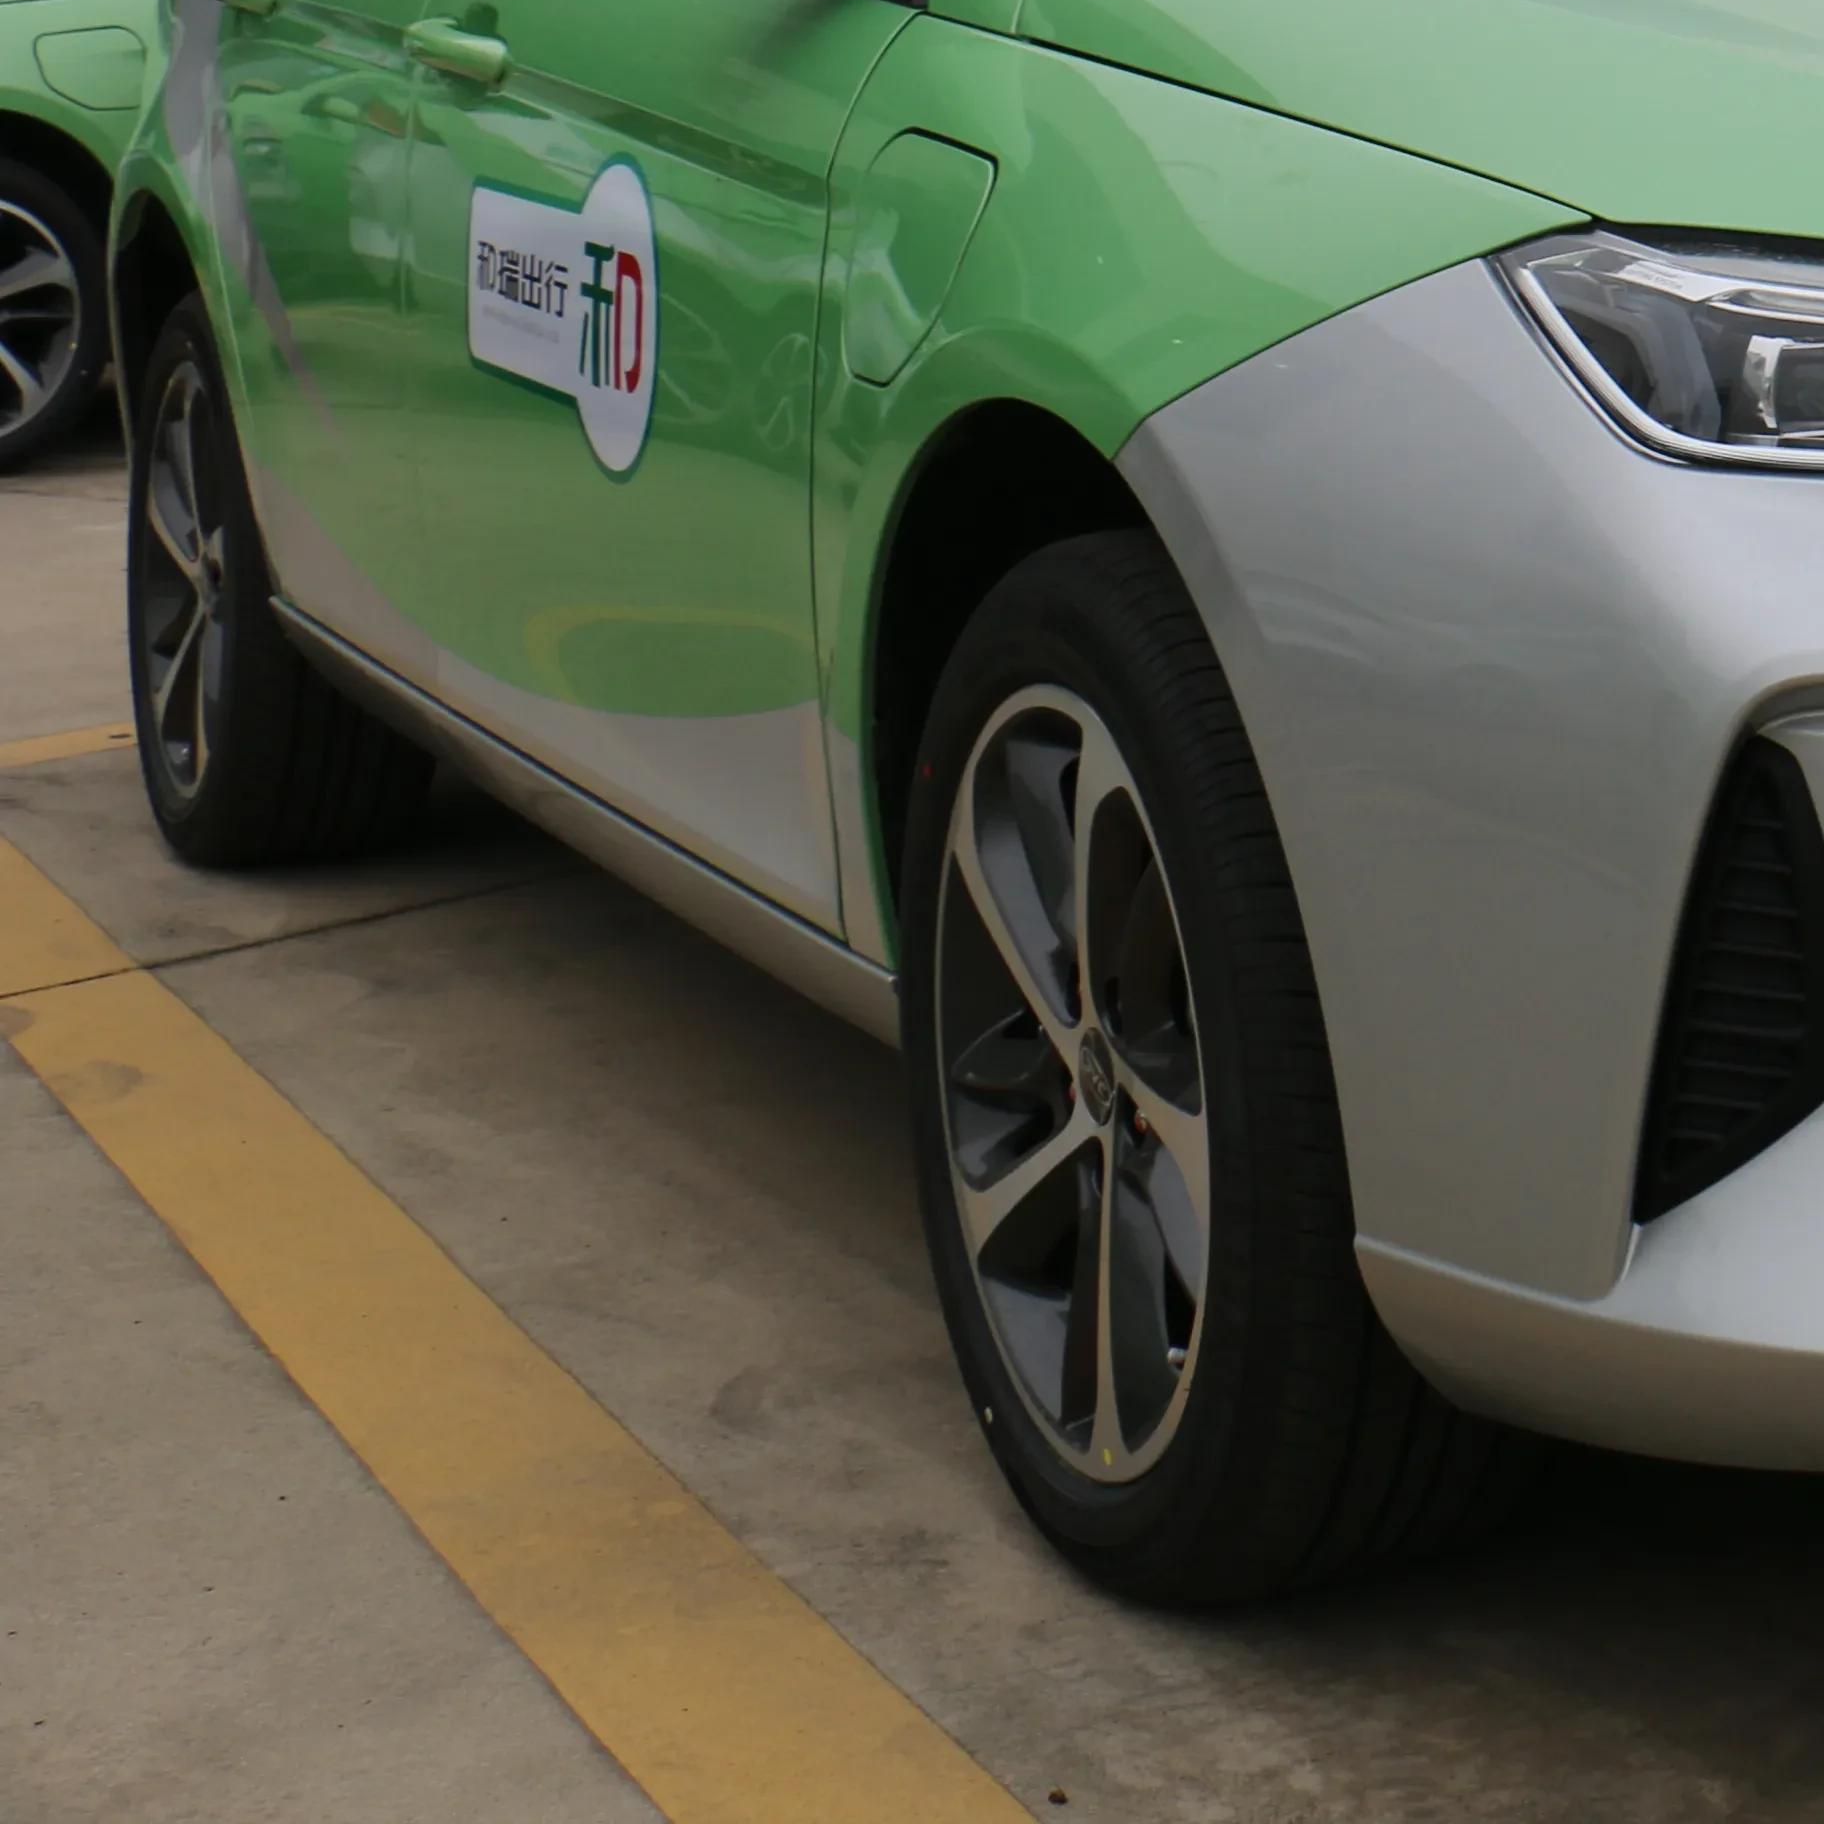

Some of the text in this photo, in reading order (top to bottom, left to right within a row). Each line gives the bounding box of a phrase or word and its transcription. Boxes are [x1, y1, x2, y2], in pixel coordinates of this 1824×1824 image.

[476, 240, 569, 318] 和瑞出行
[579, 241, 643, 393] 和
